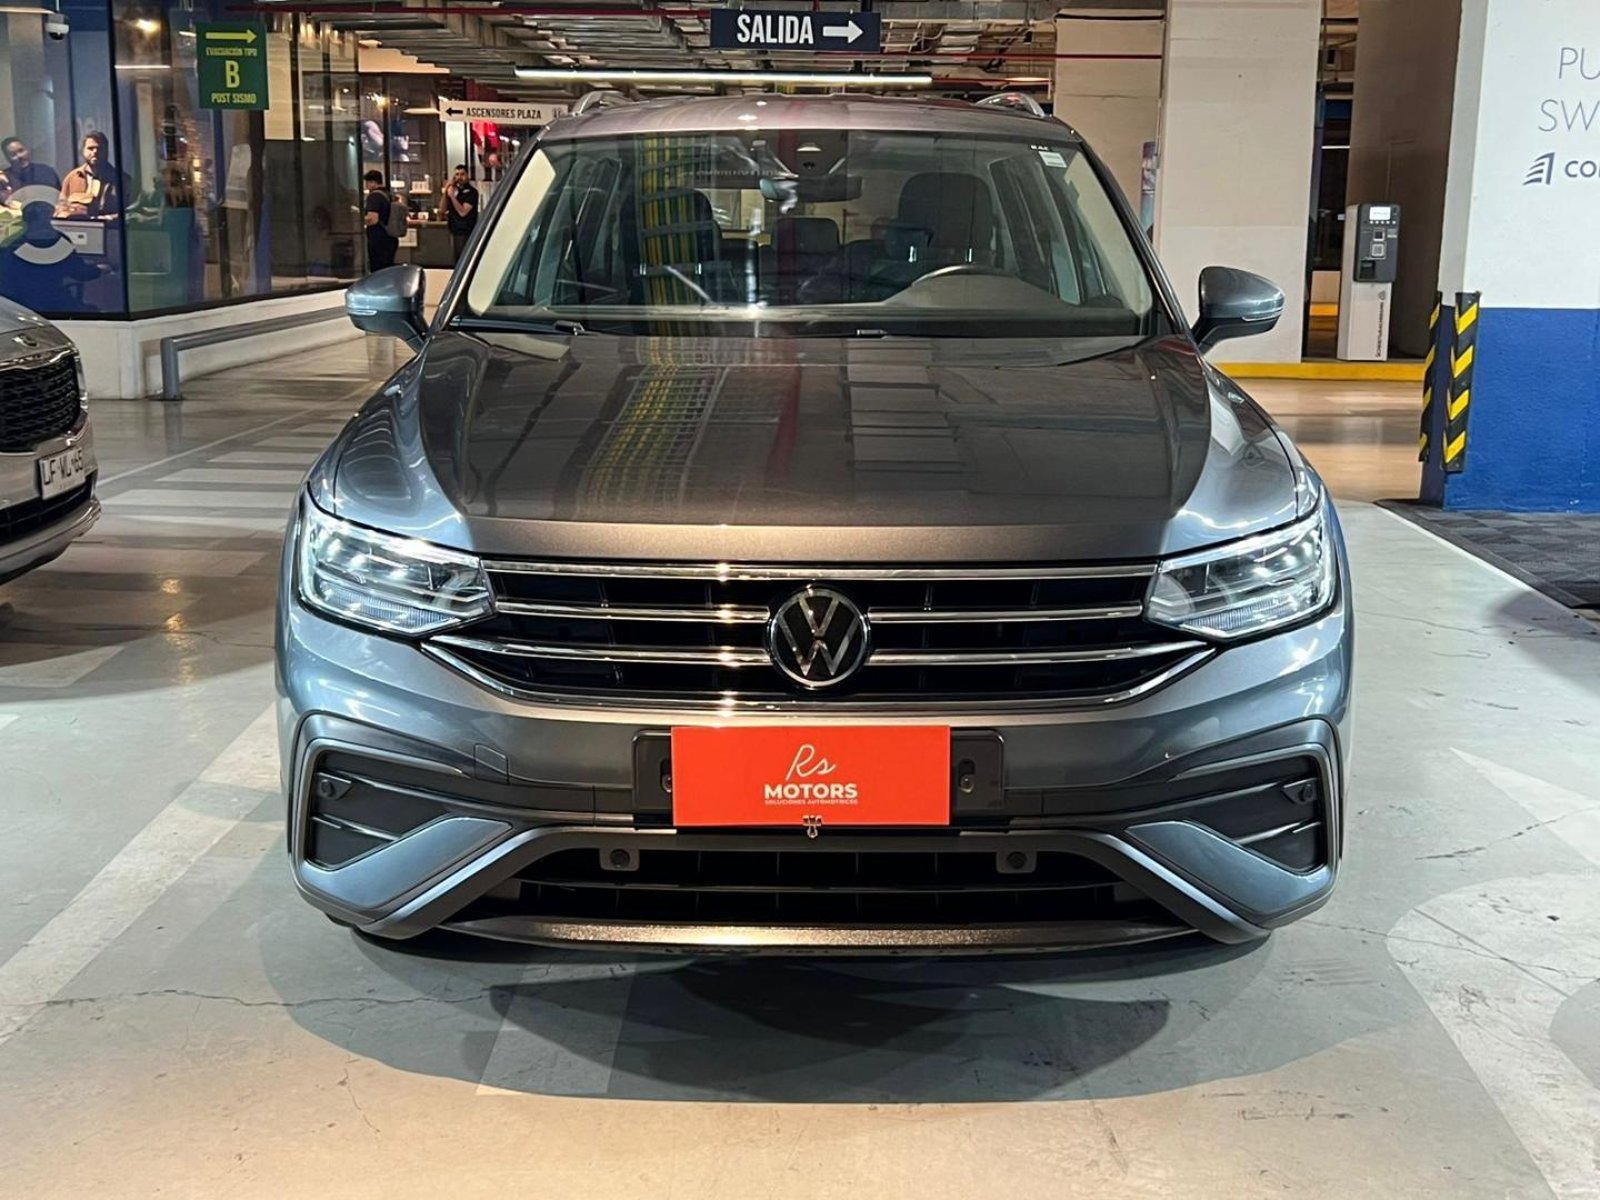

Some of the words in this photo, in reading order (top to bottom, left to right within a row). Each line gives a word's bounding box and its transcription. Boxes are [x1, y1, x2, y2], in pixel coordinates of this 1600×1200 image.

[737, 14, 814, 44] SALIDA
[225, 60, 240, 88] B
[211, 93, 231, 103] POST
[232, 93, 257, 104] SISMO
[466, 107, 516, 119] ASCENSORES
[517, 108, 542, 119] PLAZA
[785, 744, 836, 781] Rs
[764, 783, 858, 799] MOTORS
